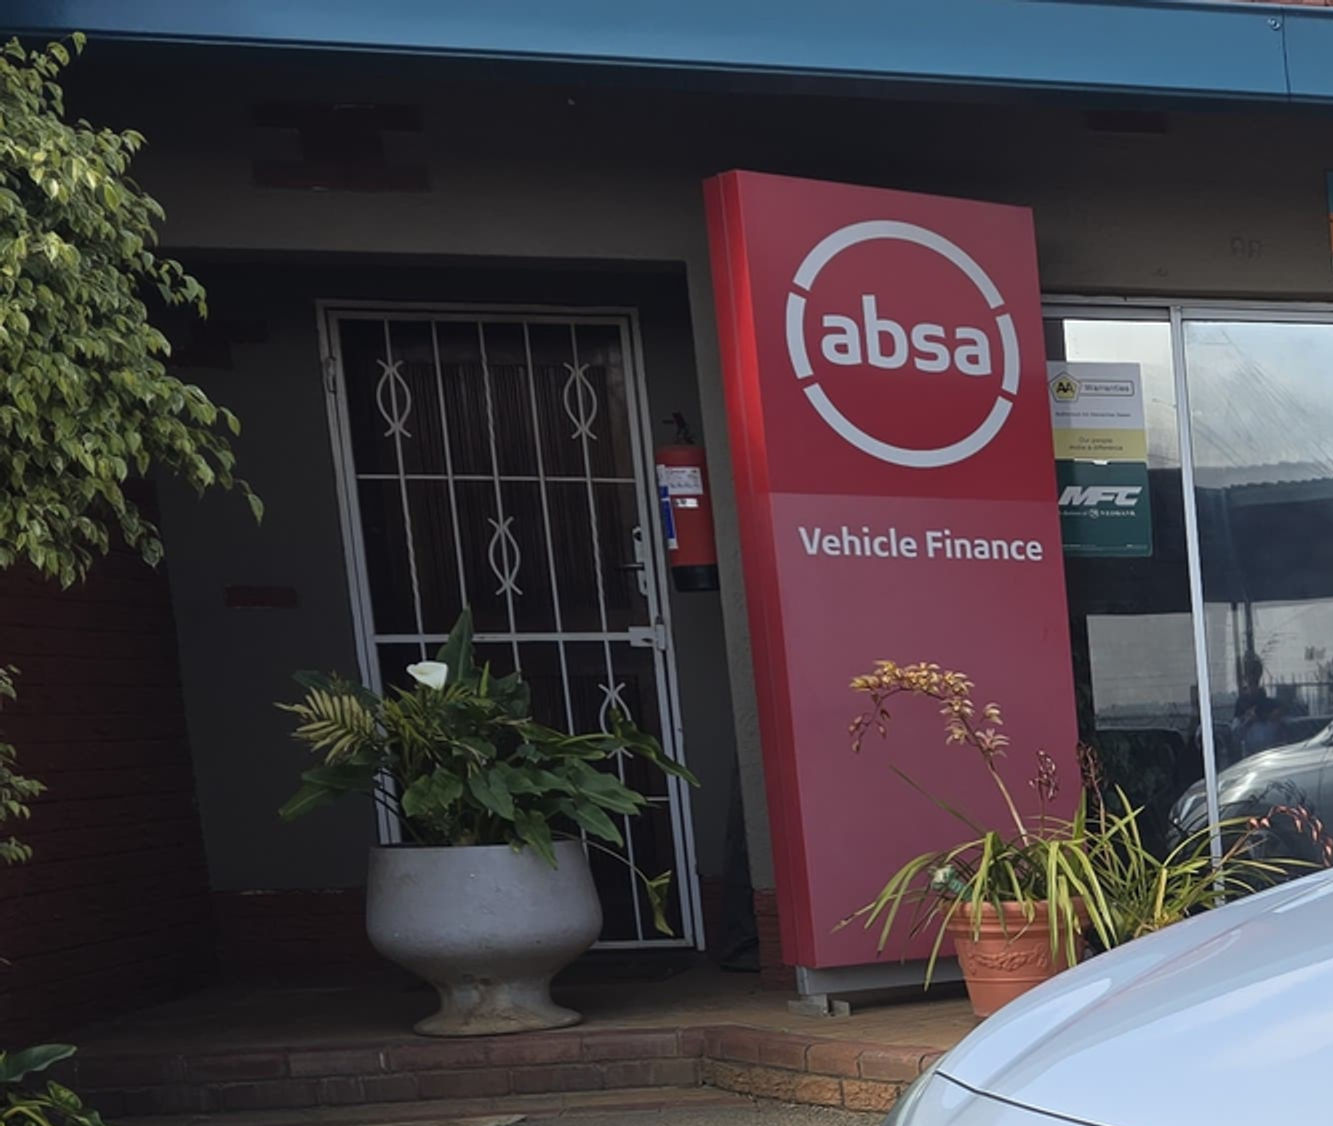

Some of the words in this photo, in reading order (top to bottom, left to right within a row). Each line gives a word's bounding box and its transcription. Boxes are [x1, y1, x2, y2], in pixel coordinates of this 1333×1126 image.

[821, 294, 992, 376] absa
[1056, 381, 1075, 393] AA
[1058, 486, 1142, 506] MFC
[798, 526, 917, 557] Vehicle
[924, 530, 1043, 561] Finance
